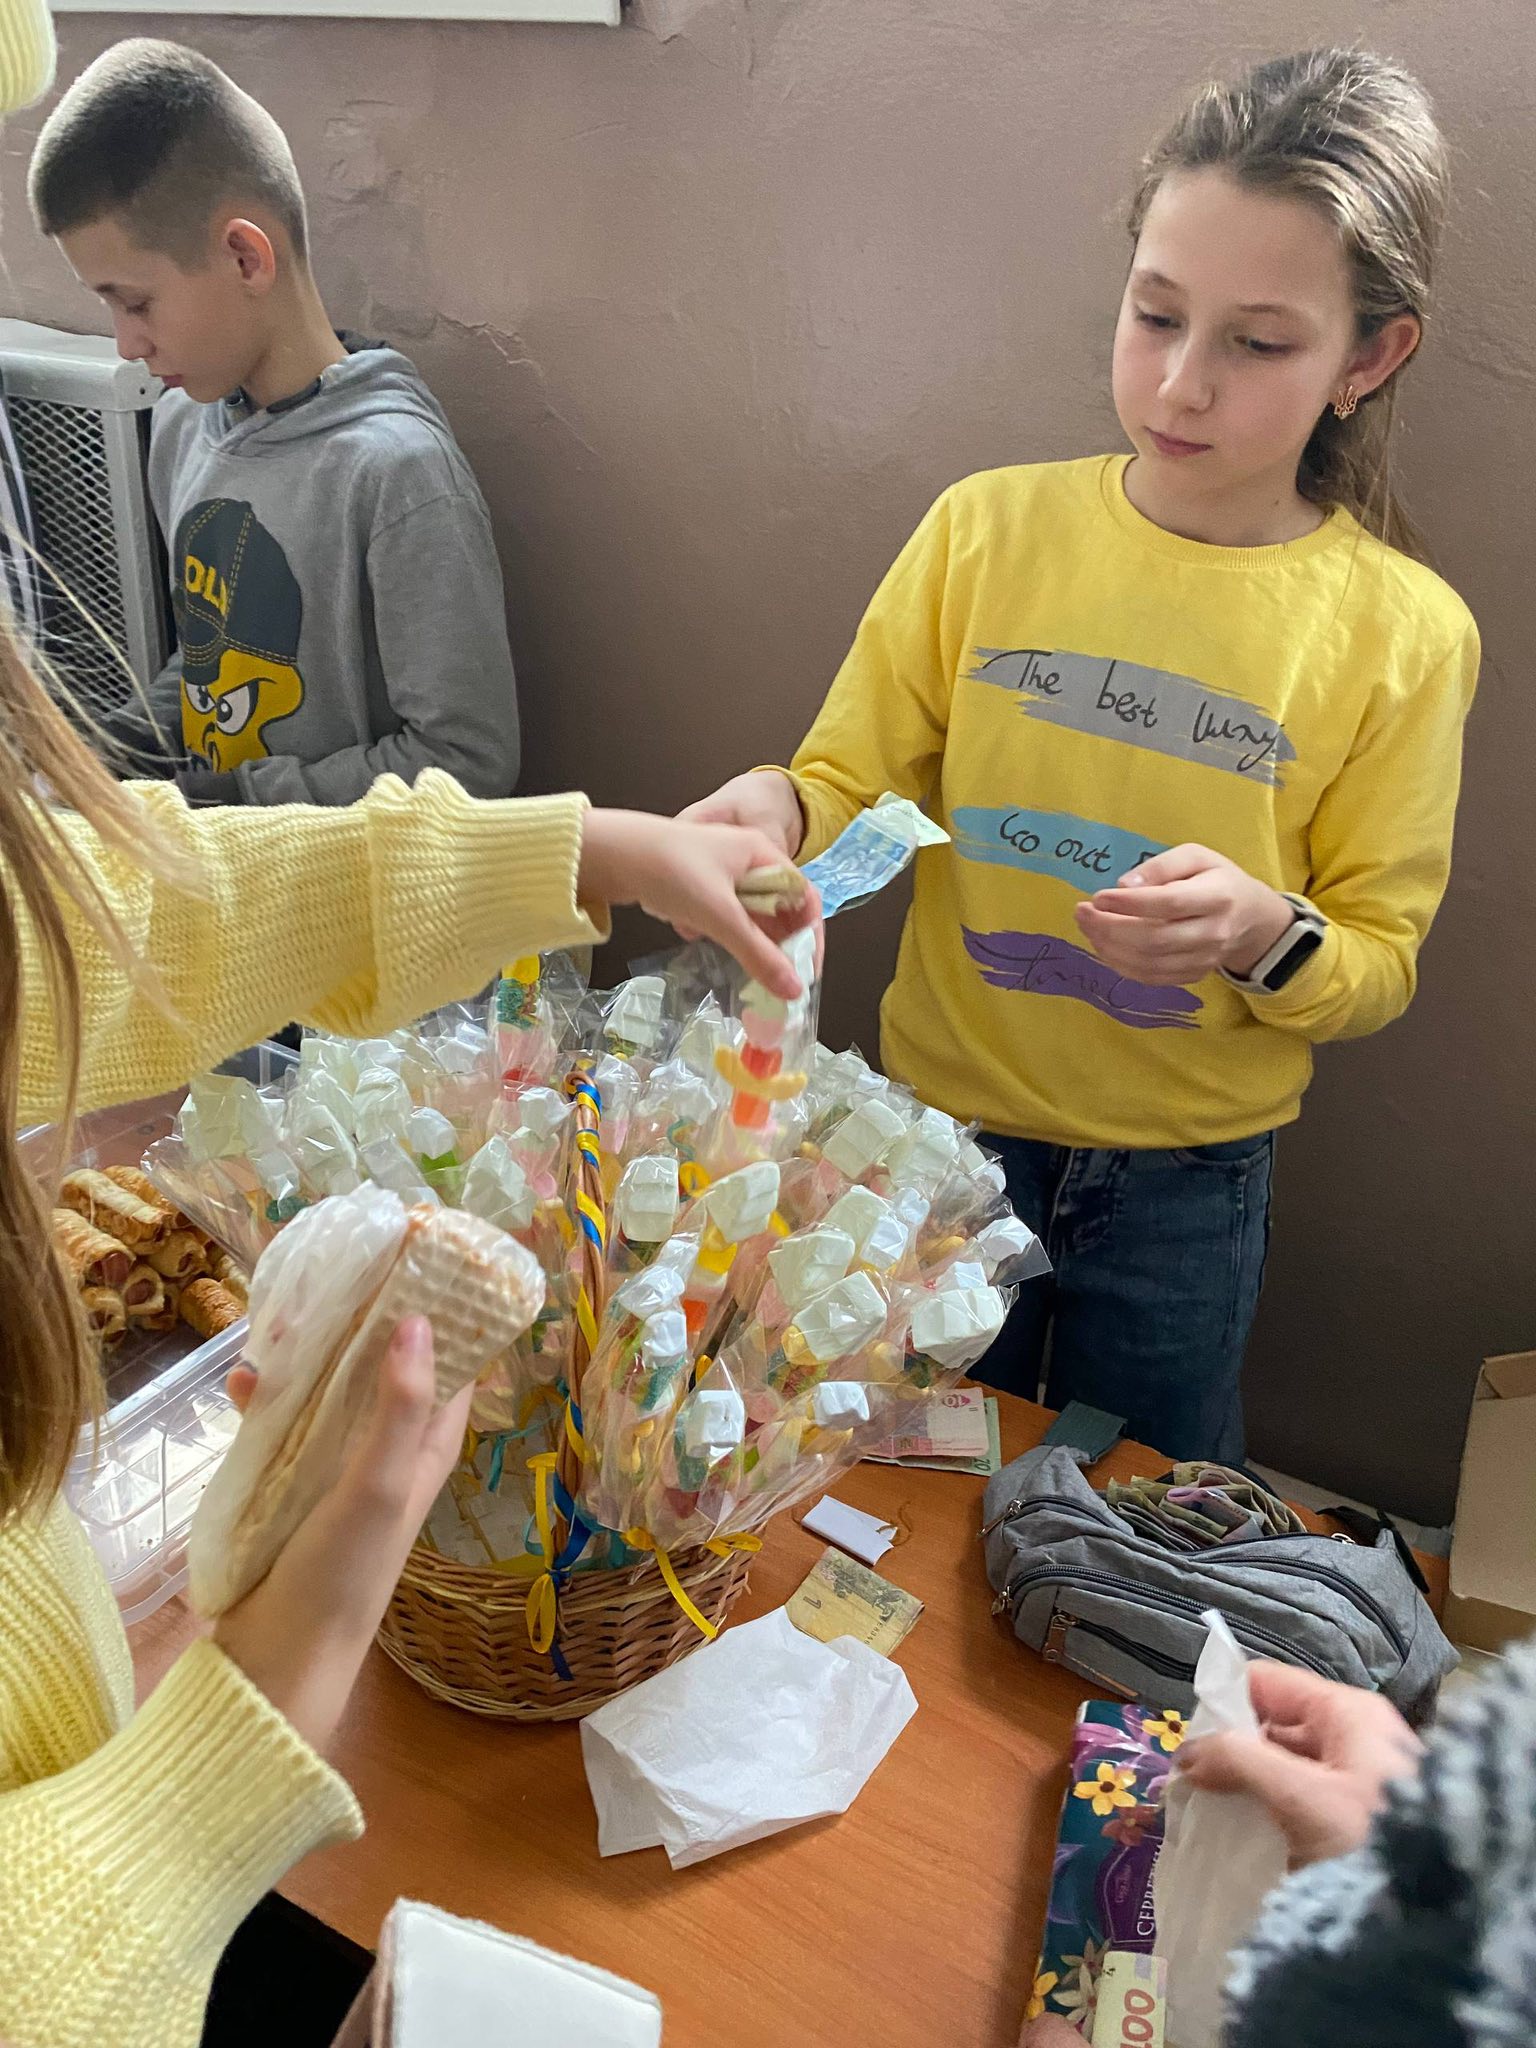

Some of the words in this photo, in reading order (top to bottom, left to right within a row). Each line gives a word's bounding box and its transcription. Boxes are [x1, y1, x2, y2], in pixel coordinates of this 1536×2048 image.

[982, 649, 1063, 696] The
[1095, 659, 1158, 728] best
[1055, 838, 1112, 873] out
[802, 1595, 822, 1610] 1
